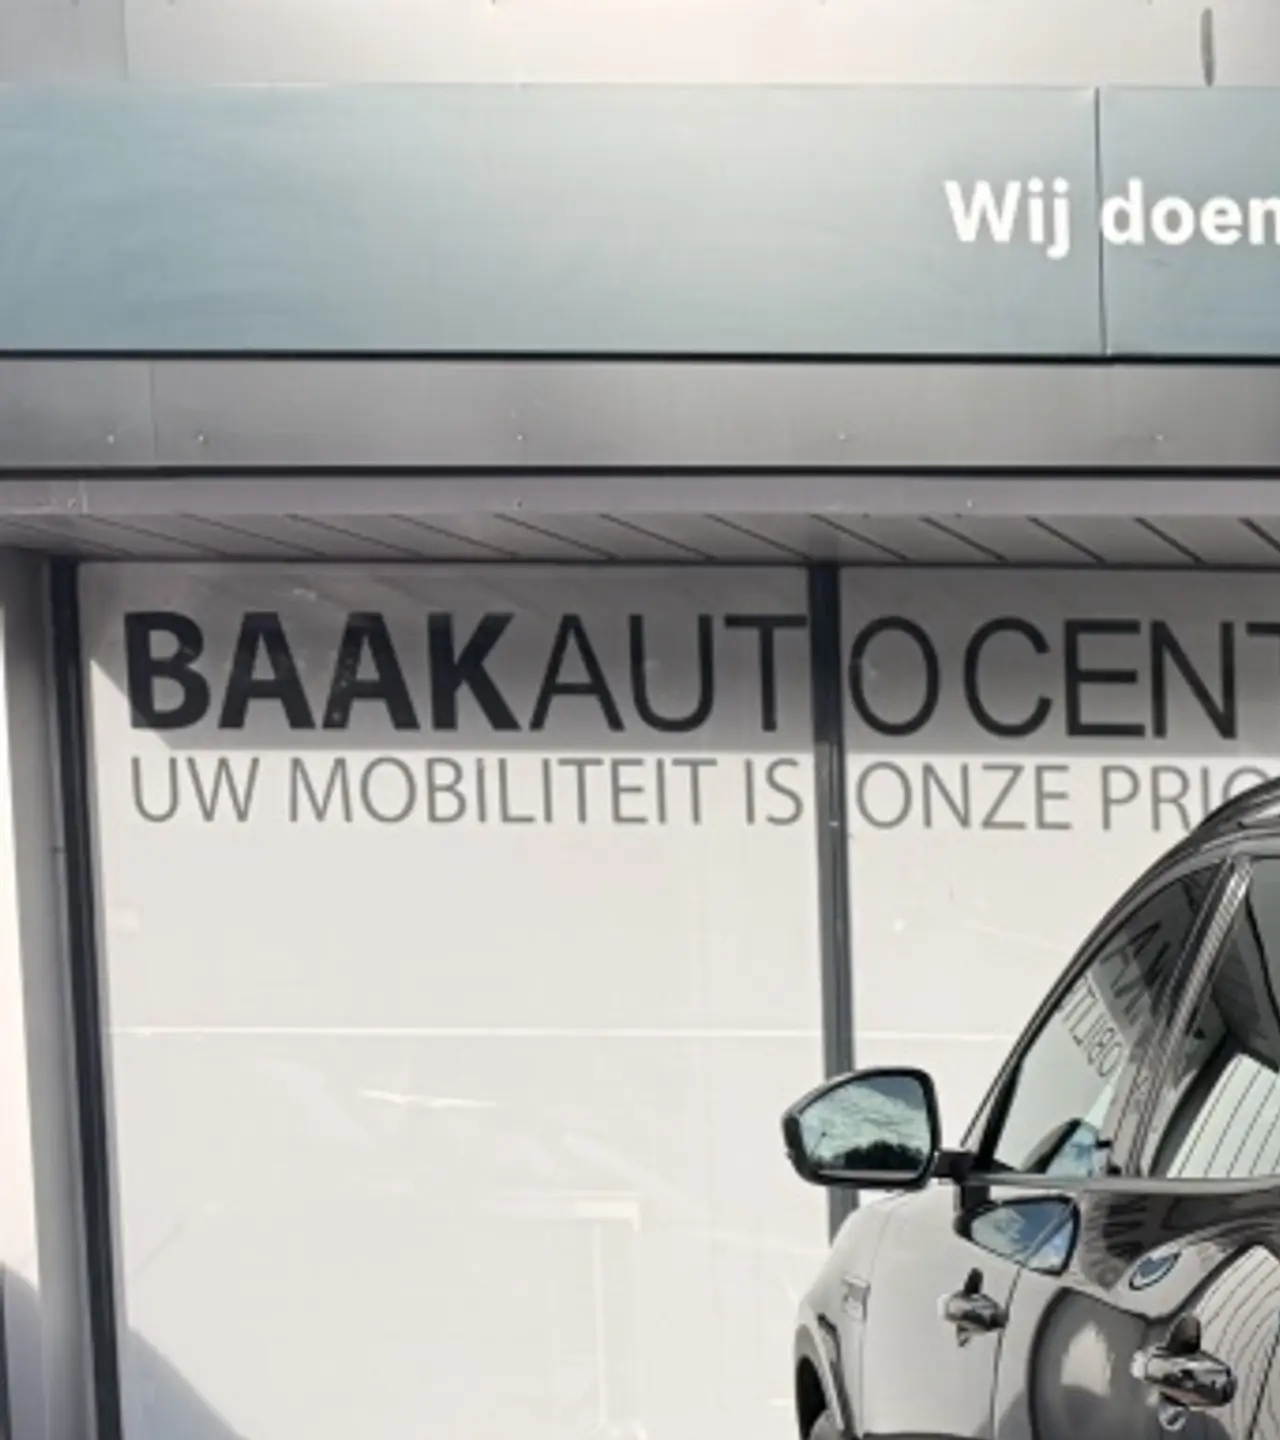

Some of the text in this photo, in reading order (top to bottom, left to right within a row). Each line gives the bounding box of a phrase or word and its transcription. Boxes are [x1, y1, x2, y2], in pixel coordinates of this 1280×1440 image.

[943, 178, 1070, 259] Wij
[130, 756, 261, 824] UW
[288, 756, 719, 825] MOBILITEIT
[743, 757, 804, 827] IS
[855, 761, 1072, 831] ONZE
